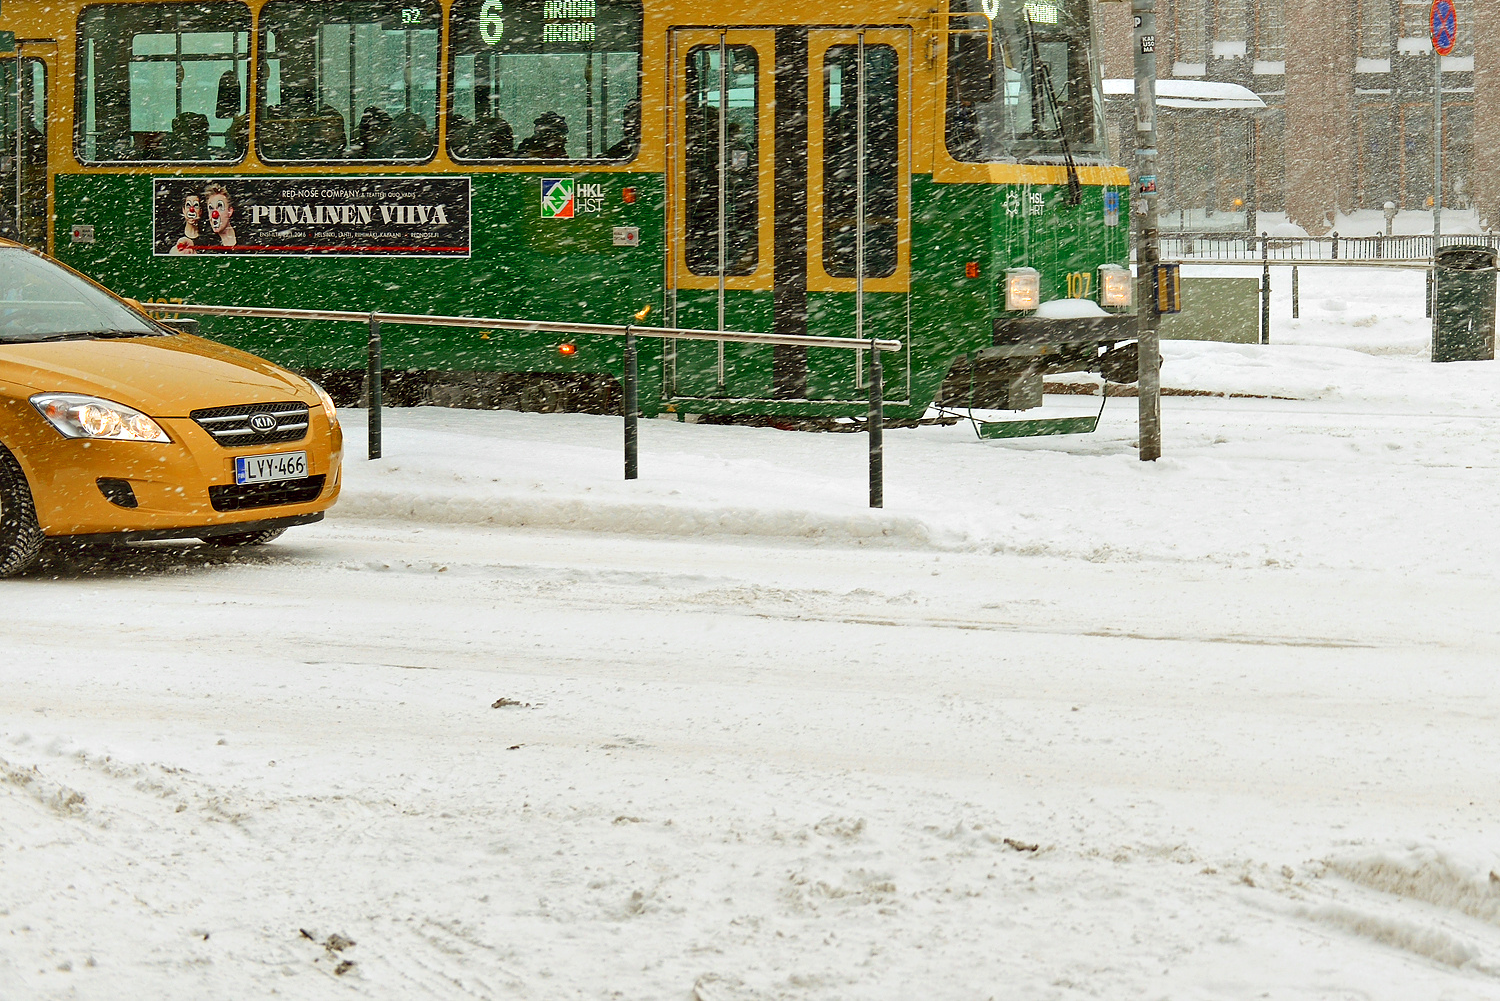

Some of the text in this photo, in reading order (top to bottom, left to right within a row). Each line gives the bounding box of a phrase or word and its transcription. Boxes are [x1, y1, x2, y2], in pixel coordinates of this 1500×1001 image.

[402, 9, 420, 23] 52
[543, 0, 596, 19] ARABIA
[543, 23, 596, 42] ARABIA
[282, 189, 319, 198] RED-NOSE
[320, 189, 360, 198] COMPANY
[577, 184, 604, 197] HKL
[1029, 192, 1045, 204] HSL
[577, 199, 604, 212] HST
[1029, 205, 1044, 216] HRT
[251, 204, 449, 225] PUNAINEN VIIVA
[1066, 272, 1092, 299] 107
[255, 417, 274, 427] KIA
[247, 456, 305, 479] LVY-466
